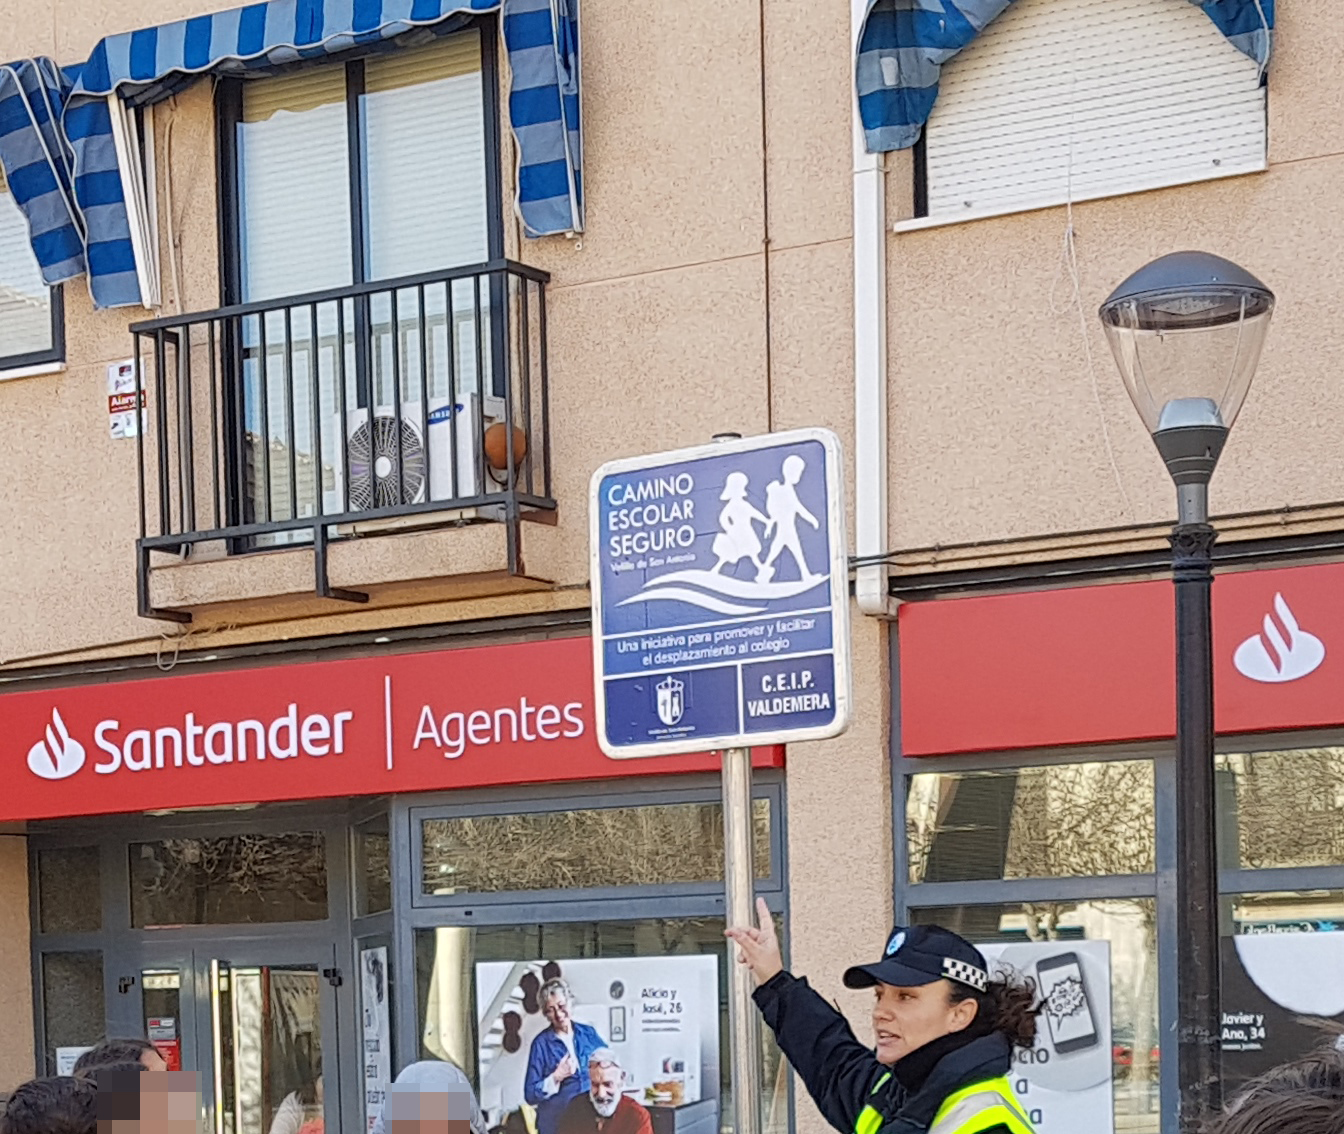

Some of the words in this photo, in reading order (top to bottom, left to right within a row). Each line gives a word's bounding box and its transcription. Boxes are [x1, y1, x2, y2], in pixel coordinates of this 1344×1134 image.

[608, 473, 694, 506] CAMINO
[608, 499, 694, 531] ESCOLAR
[610, 525, 695, 557] SEGURO
[617, 640, 639, 654] Una
[641, 634, 686, 650] iniciativa
[688, 632, 712, 647] para
[714, 625, 764, 644] promover
[767, 624, 774, 635] y
[776, 618, 815, 634] facilitar
[643, 653, 653, 666] el
[655, 643, 736, 666] desplazamiento
[738, 641, 748, 654] al
[751, 637, 790, 653] colegio
[762, 670, 815, 693] C.E.I.P.
[747, 693, 831, 718] VALDEMERA
[94, 703, 353, 775] Santander
[412, 697, 585, 760] Agentes
[669, 1002, 683, 1013] 26
[1222, 1012, 1255, 1025] Javier
[1256, 1014, 1263, 1026] y
[1250, 1027, 1265, 1039] 34
